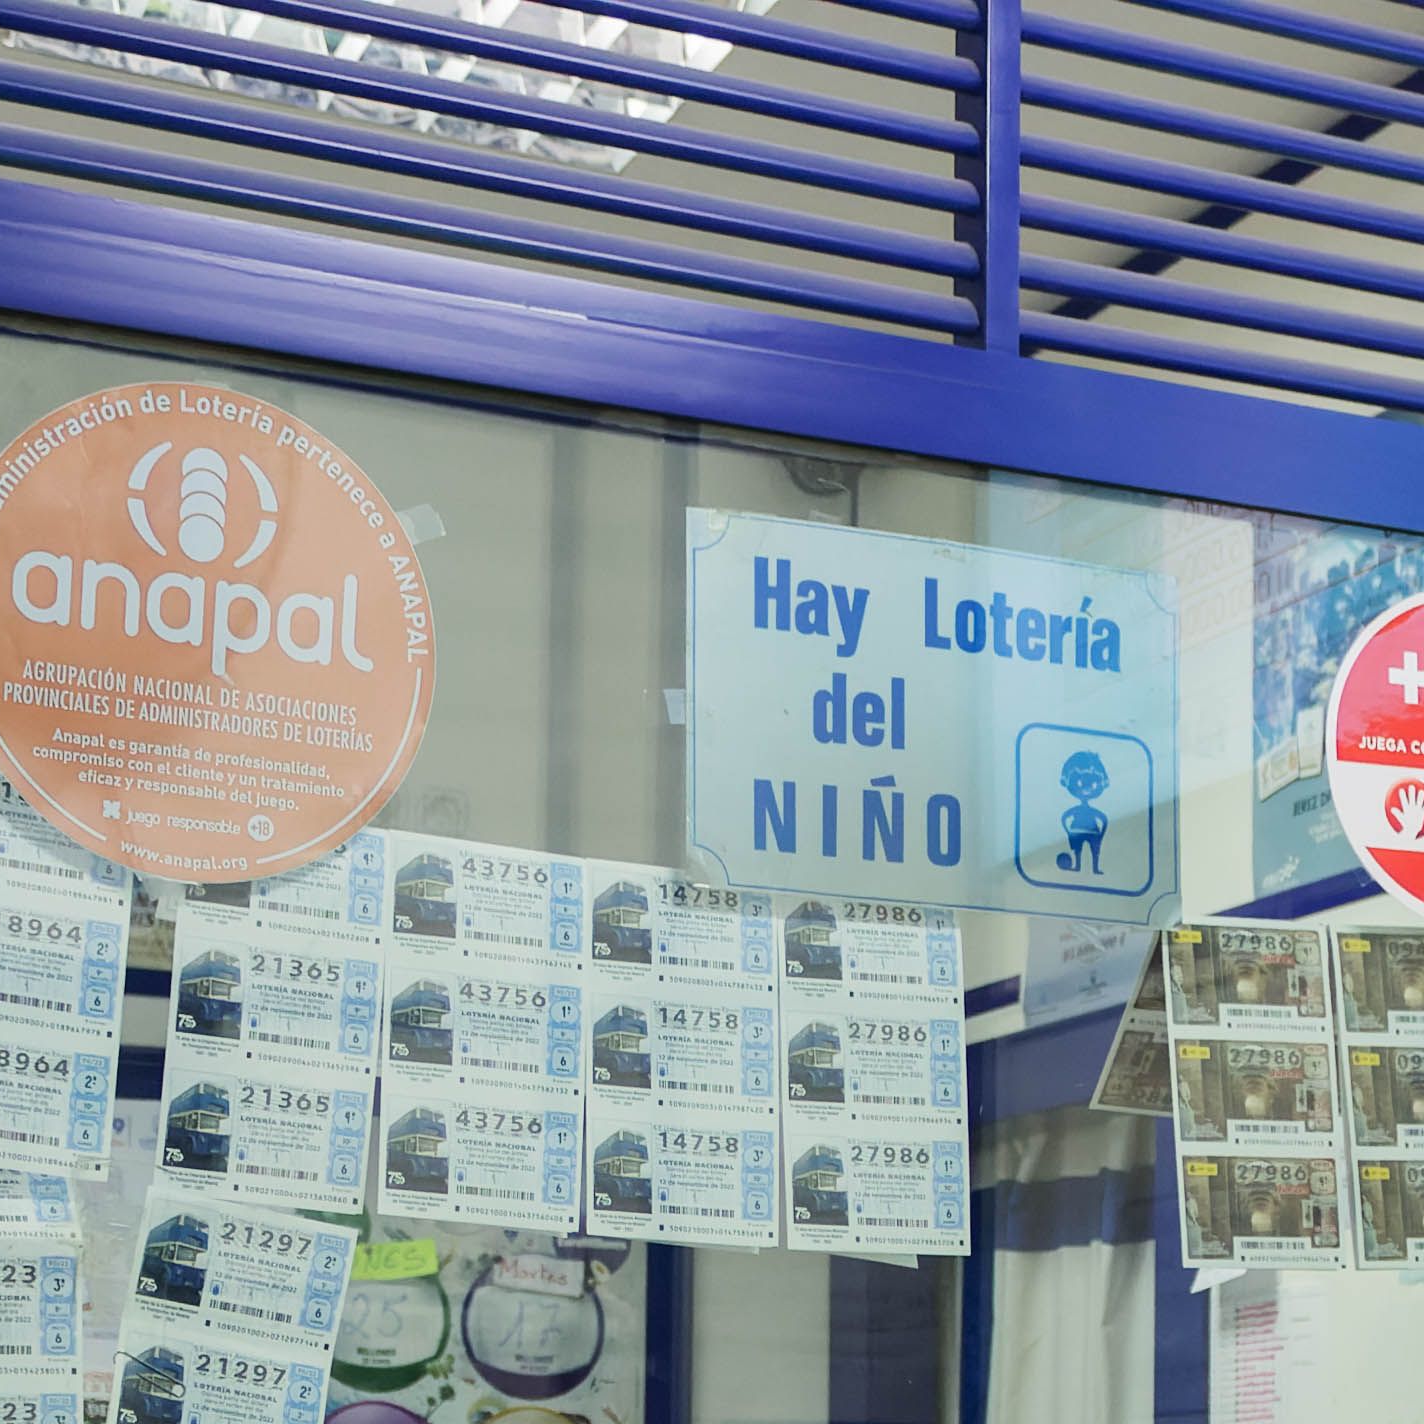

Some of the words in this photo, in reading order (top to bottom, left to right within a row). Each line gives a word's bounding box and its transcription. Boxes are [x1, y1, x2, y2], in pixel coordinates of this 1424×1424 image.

[140, 390, 171, 414] de
[179, 389, 274, 434] Lotería
[276, 425, 384, 529] pertenece
[379, 532, 395, 549] a
[388, 555, 429, 663] ANAPAL
[11, 551, 374, 676] anapal
[754, 556, 870, 658] Hay
[924, 577, 1121, 673] Lotería
[3, 682, 110, 715] PROVINCIALES
[115, 699, 135, 719] DE
[138, 702, 278, 739] ADMINISTRADORES
[283, 722, 302, 743] DE
[306, 728, 373, 752] LOTERÍAS
[23, 659, 126, 693] AGRUPACIÓN
[133, 675, 213, 706] NACIONAL
[221, 688, 240, 709] DE
[245, 692, 357, 726] ASOCIACIONES
[812, 672, 906, 750] del
[52, 728, 105, 748] Anapal
[108, 737, 126, 751] es
[129, 741, 189, 759] garantía
[195, 747, 212, 761] de
[215, 753, 331, 780] profesionalidad,
[1358, 736, 1406, 753] JUEGA
[753, 775, 962, 868] NIÑO
[120, 840, 249, 871] www.anapal.org
[250, 954, 341, 982] 21365
[659, 1007, 739, 1030] 14758
[848, 1021, 928, 1042] 27986
[455, 1109, 543, 1135] 43756
[221, 1221, 314, 1255] 21297
